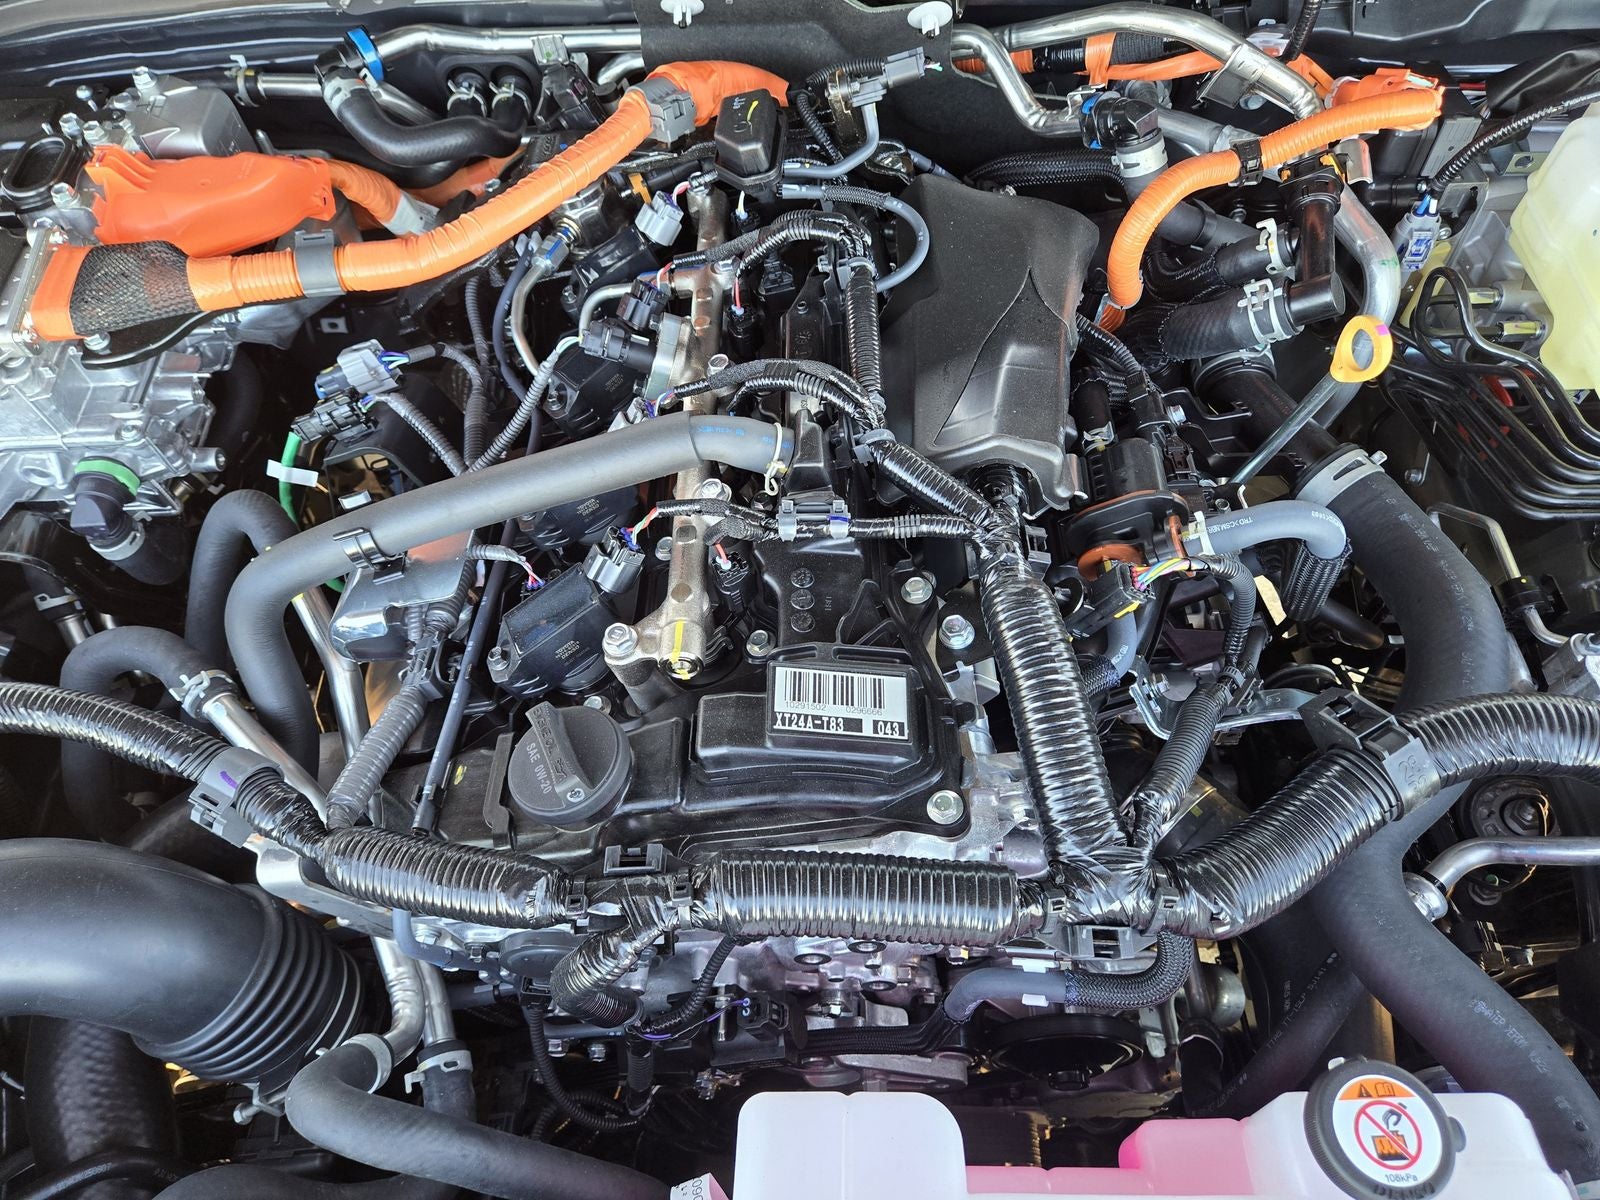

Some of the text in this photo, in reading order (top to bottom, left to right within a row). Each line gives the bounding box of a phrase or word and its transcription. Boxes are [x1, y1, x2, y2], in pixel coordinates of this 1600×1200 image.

[576, 498, 596, 510] TOYOTA
[582, 503, 600, 516] DENSO
[555, 640, 575, 654] TOYOTA
[561, 645, 580, 659] DENSO
[785, 700, 827, 712] 10291502
[775, 712, 900, 737] XT24A-T83 043
[526, 742, 552, 794] SAE 0W-20
[1385, 1173, 1418, 1183] 108kPa
